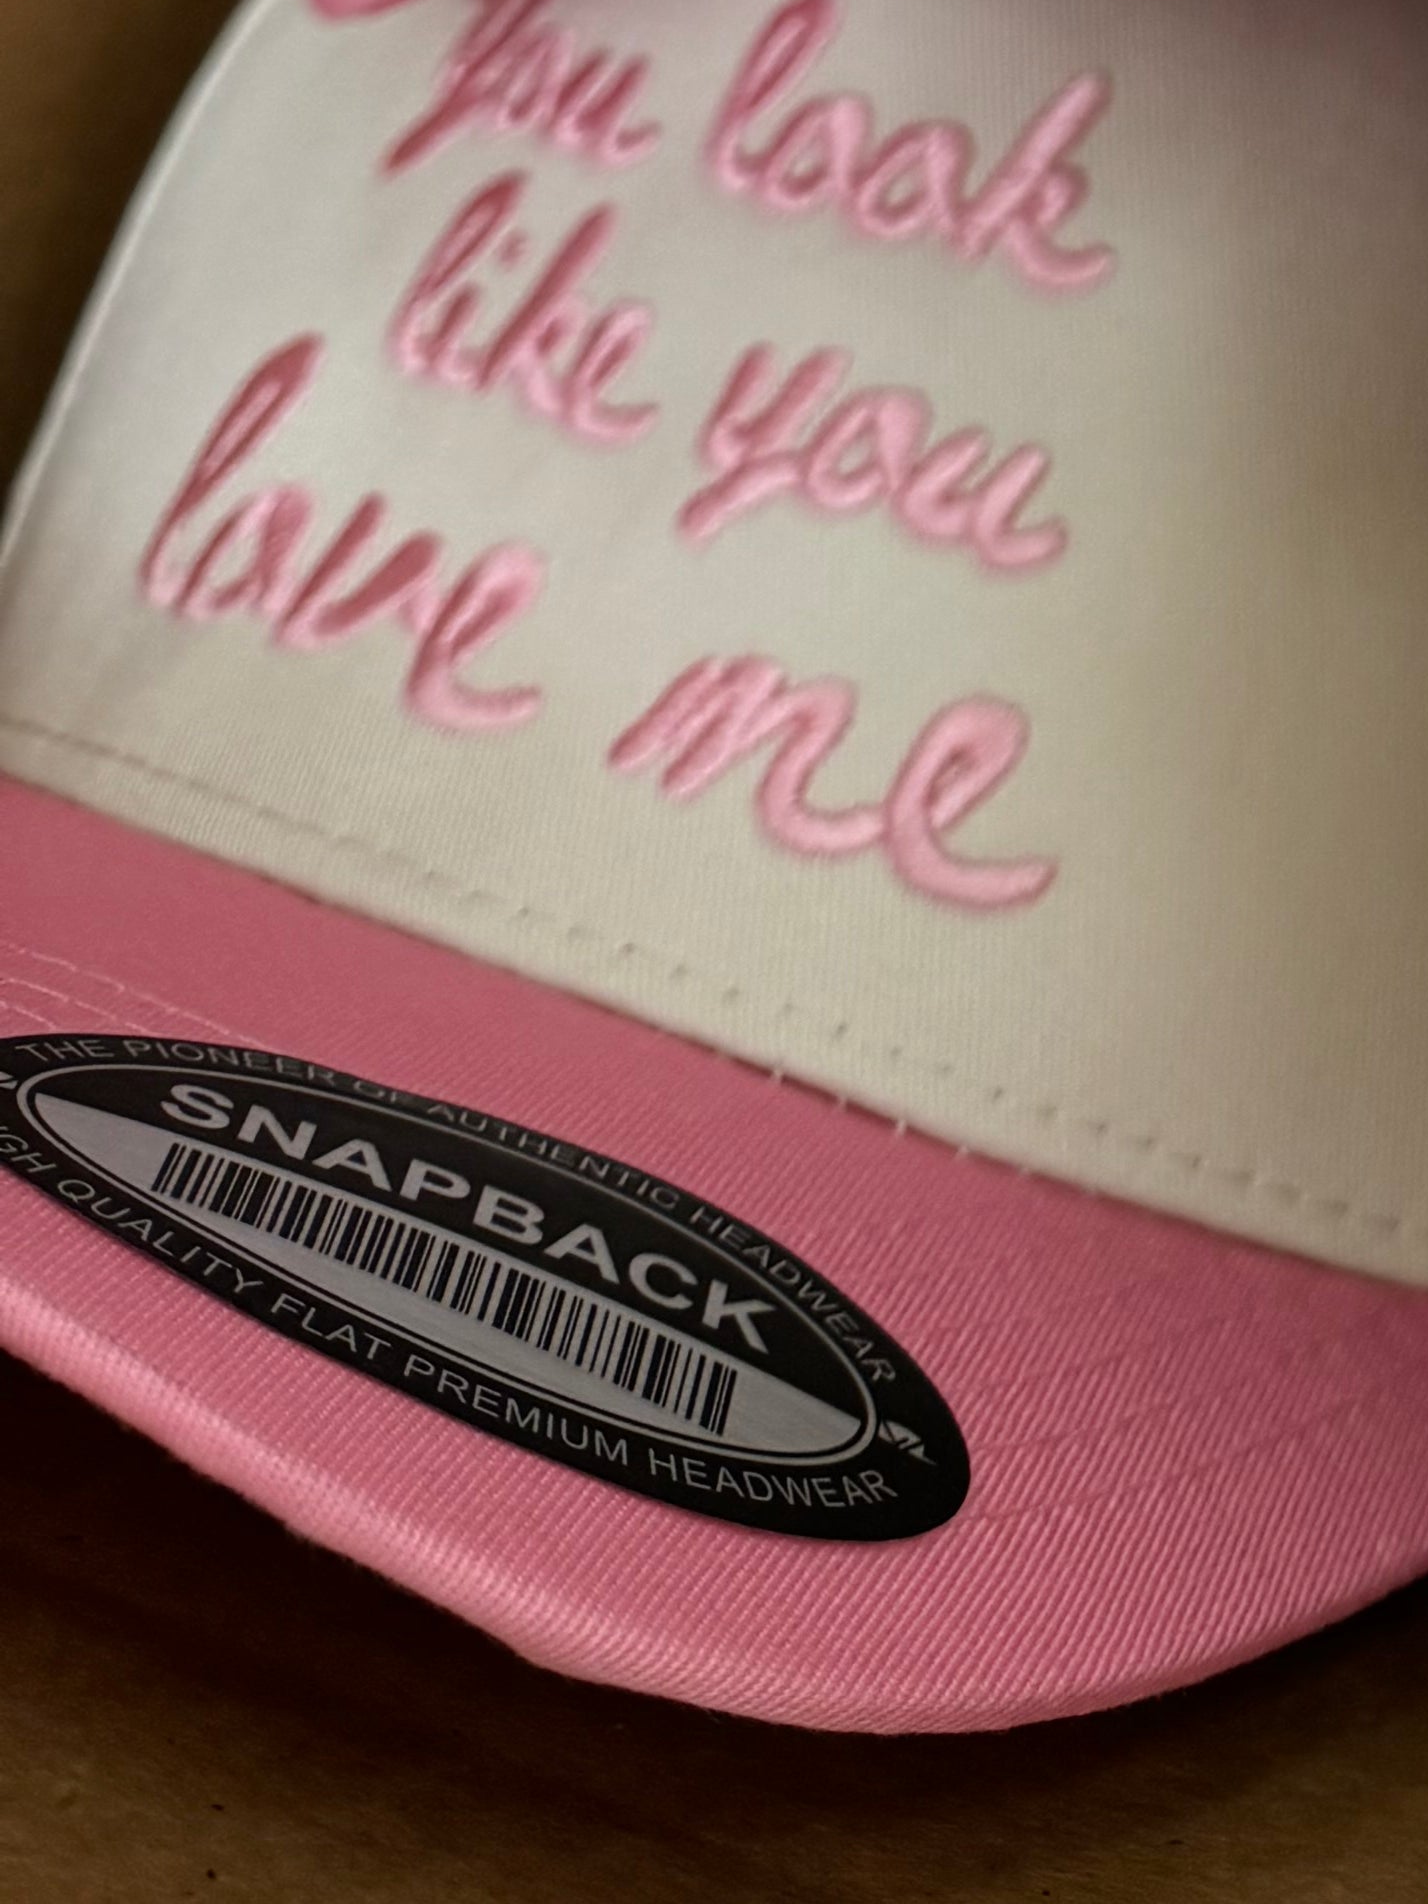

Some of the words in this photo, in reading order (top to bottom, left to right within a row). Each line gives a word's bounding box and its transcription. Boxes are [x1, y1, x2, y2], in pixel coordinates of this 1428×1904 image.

[388, 170, 658, 447] like
[675, 344, 1069, 578] you
[137, 333, 543, 733] love
[605, 653, 1058, 916] me
[15, 1038, 115, 1063] THE
[122, 1039, 336, 1088] PIONEER
[427, 1103, 680, 1211] AUTHENTIC
[689, 1204, 897, 1383] HEADWEAR
[57, 1178, 264, 1294] QUALITY
[270, 1292, 393, 1362] FLAT
[403, 1353, 628, 1467] PREMIUM
[648, 1447, 899, 1508] HEADWEAR
[160, 1083, 777, 1355] SNAPBACK
